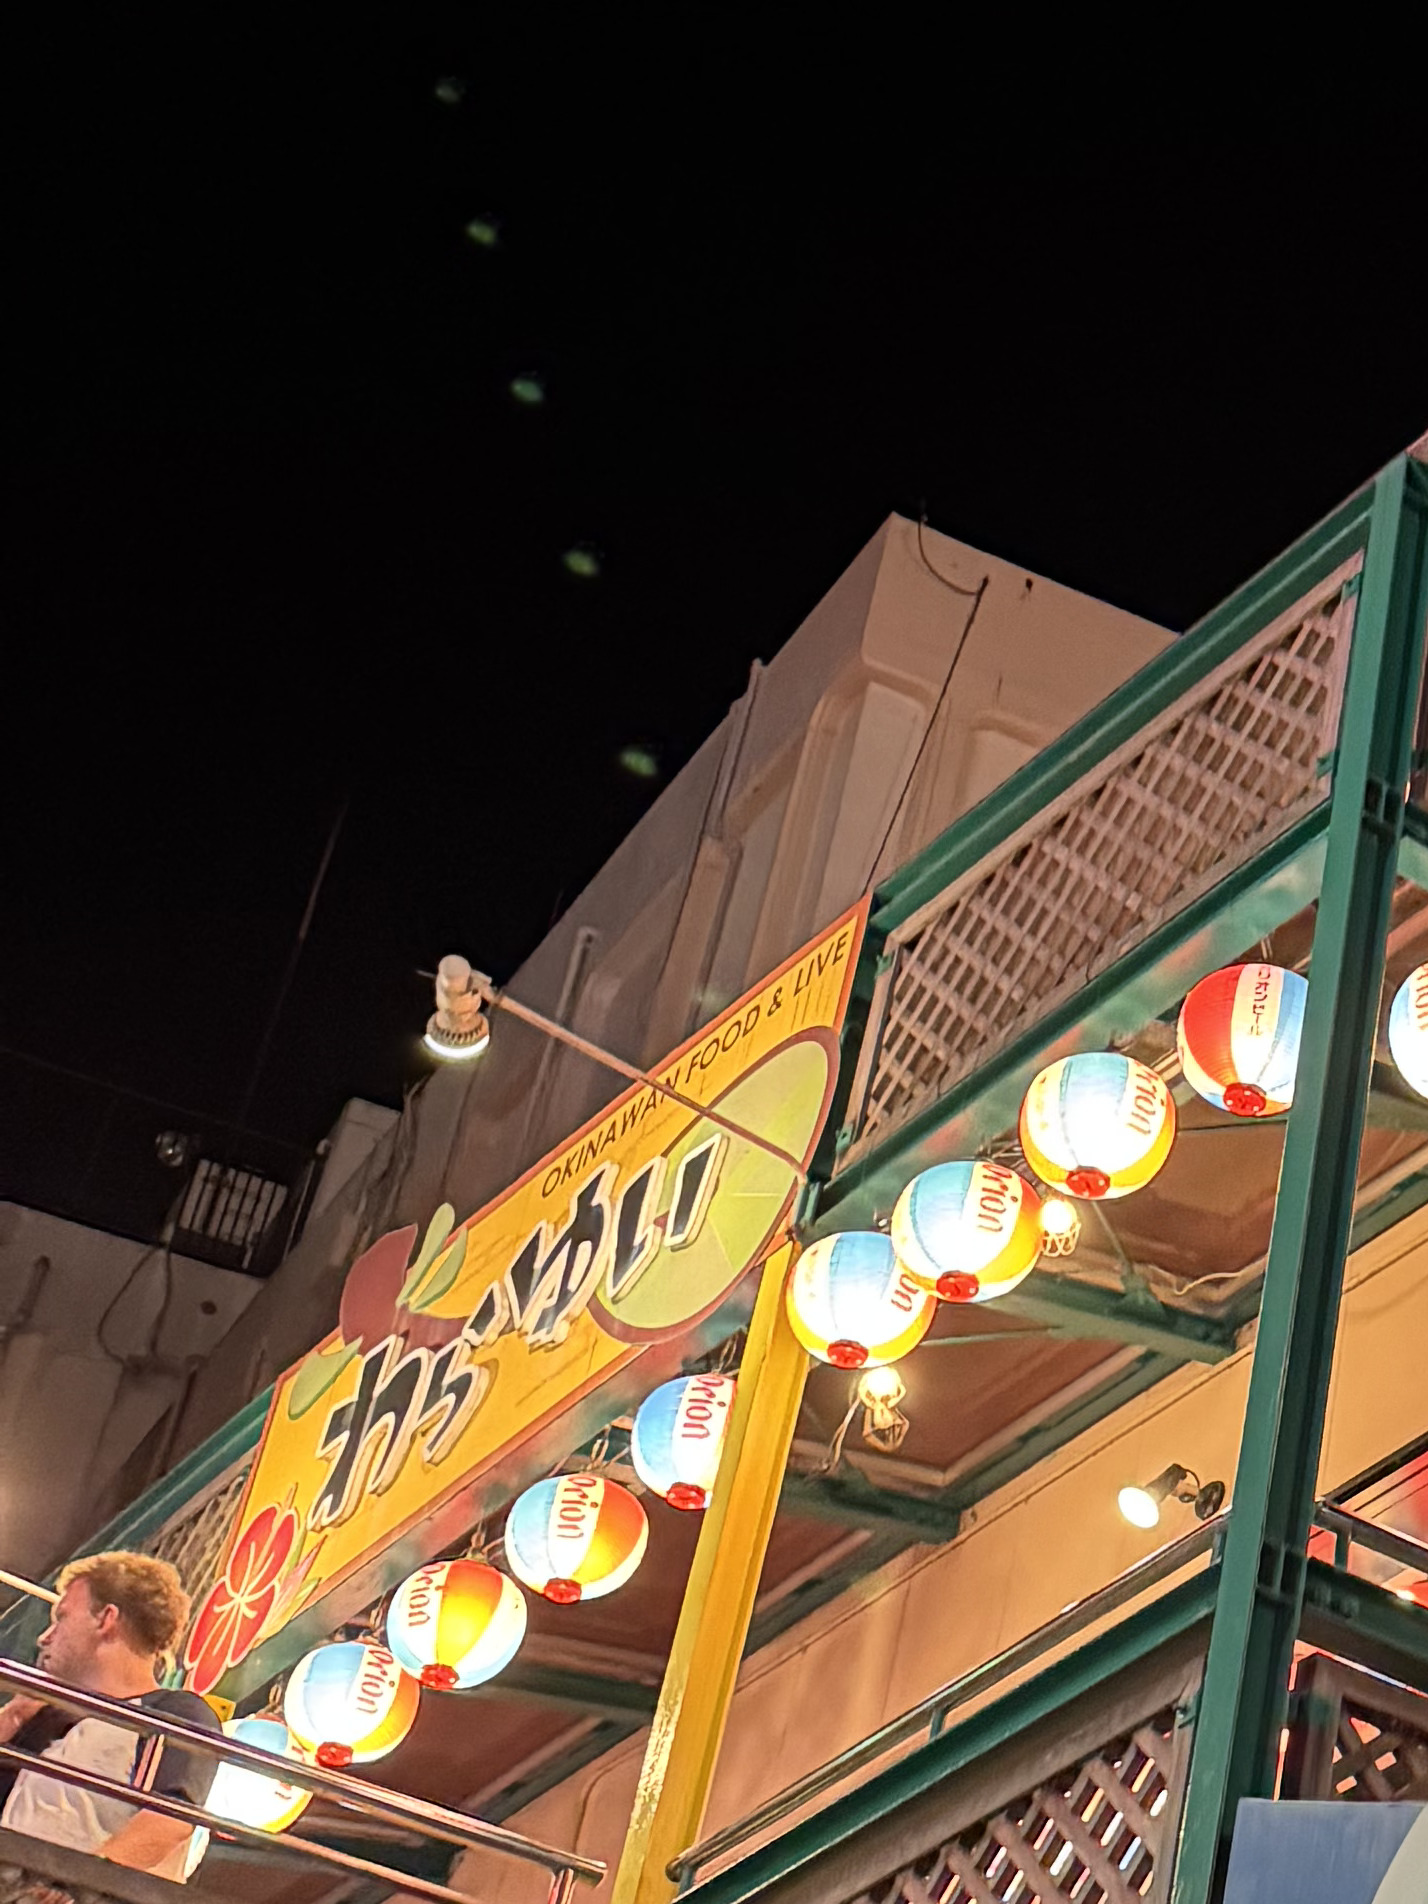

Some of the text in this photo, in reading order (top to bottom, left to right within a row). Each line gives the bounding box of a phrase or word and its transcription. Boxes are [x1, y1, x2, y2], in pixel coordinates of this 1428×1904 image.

[541, 930, 849, 1199] OKINAWAN FOOD & LIVE
[309, 1133, 728, 1529] わらゆい
[681, 1375, 727, 1439] Orion
[556, 1476, 599, 1540] Orion
[408, 1563, 447, 1628] Orion
[356, 1646, 396, 1715] Orion
